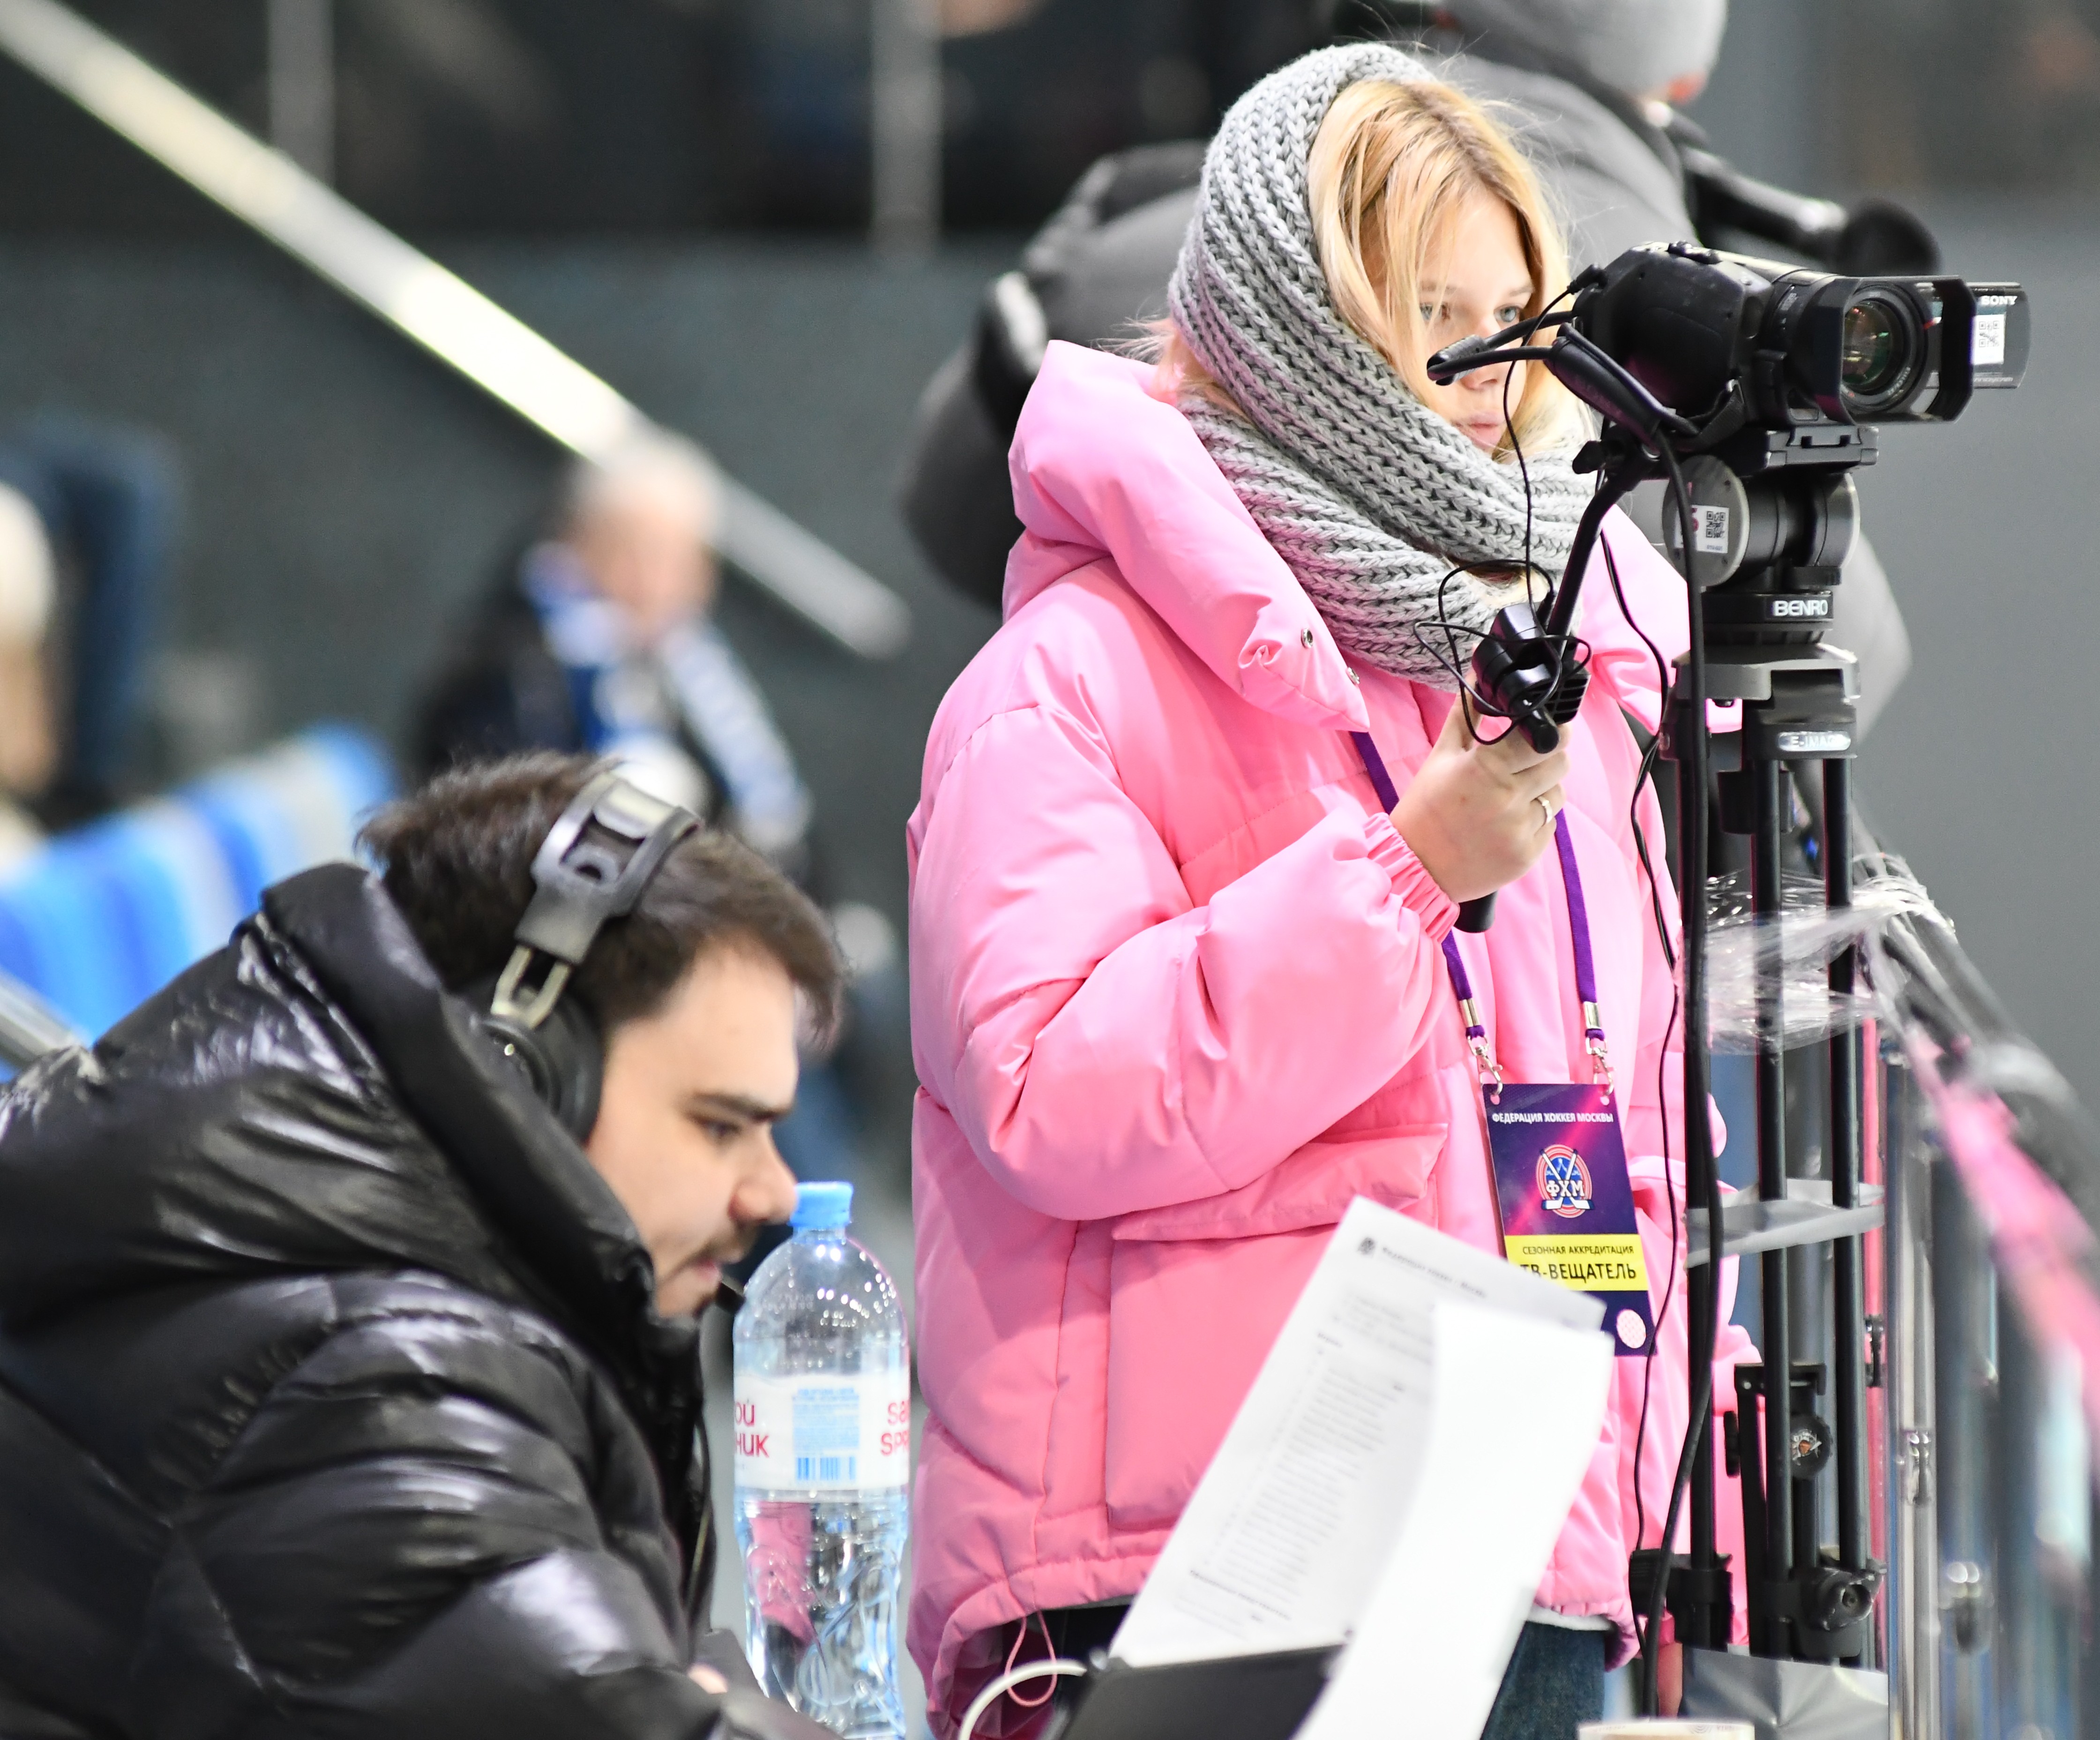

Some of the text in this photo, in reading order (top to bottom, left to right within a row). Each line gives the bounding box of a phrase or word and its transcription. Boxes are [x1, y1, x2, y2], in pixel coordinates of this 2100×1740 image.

[1981, 295, 2018, 306] SONY
[1773, 600, 1828, 616] BENRO
[1492, 1112, 1614, 1125] ФЕДЕРАЦИЯ ХОККЕЯ МОСКВЫ
[1546, 1180, 1585, 1197] ФХМ
[1523, 1245, 1635, 1256] СЕЗОННАЯ АККРЕДИТАЦИЯ
